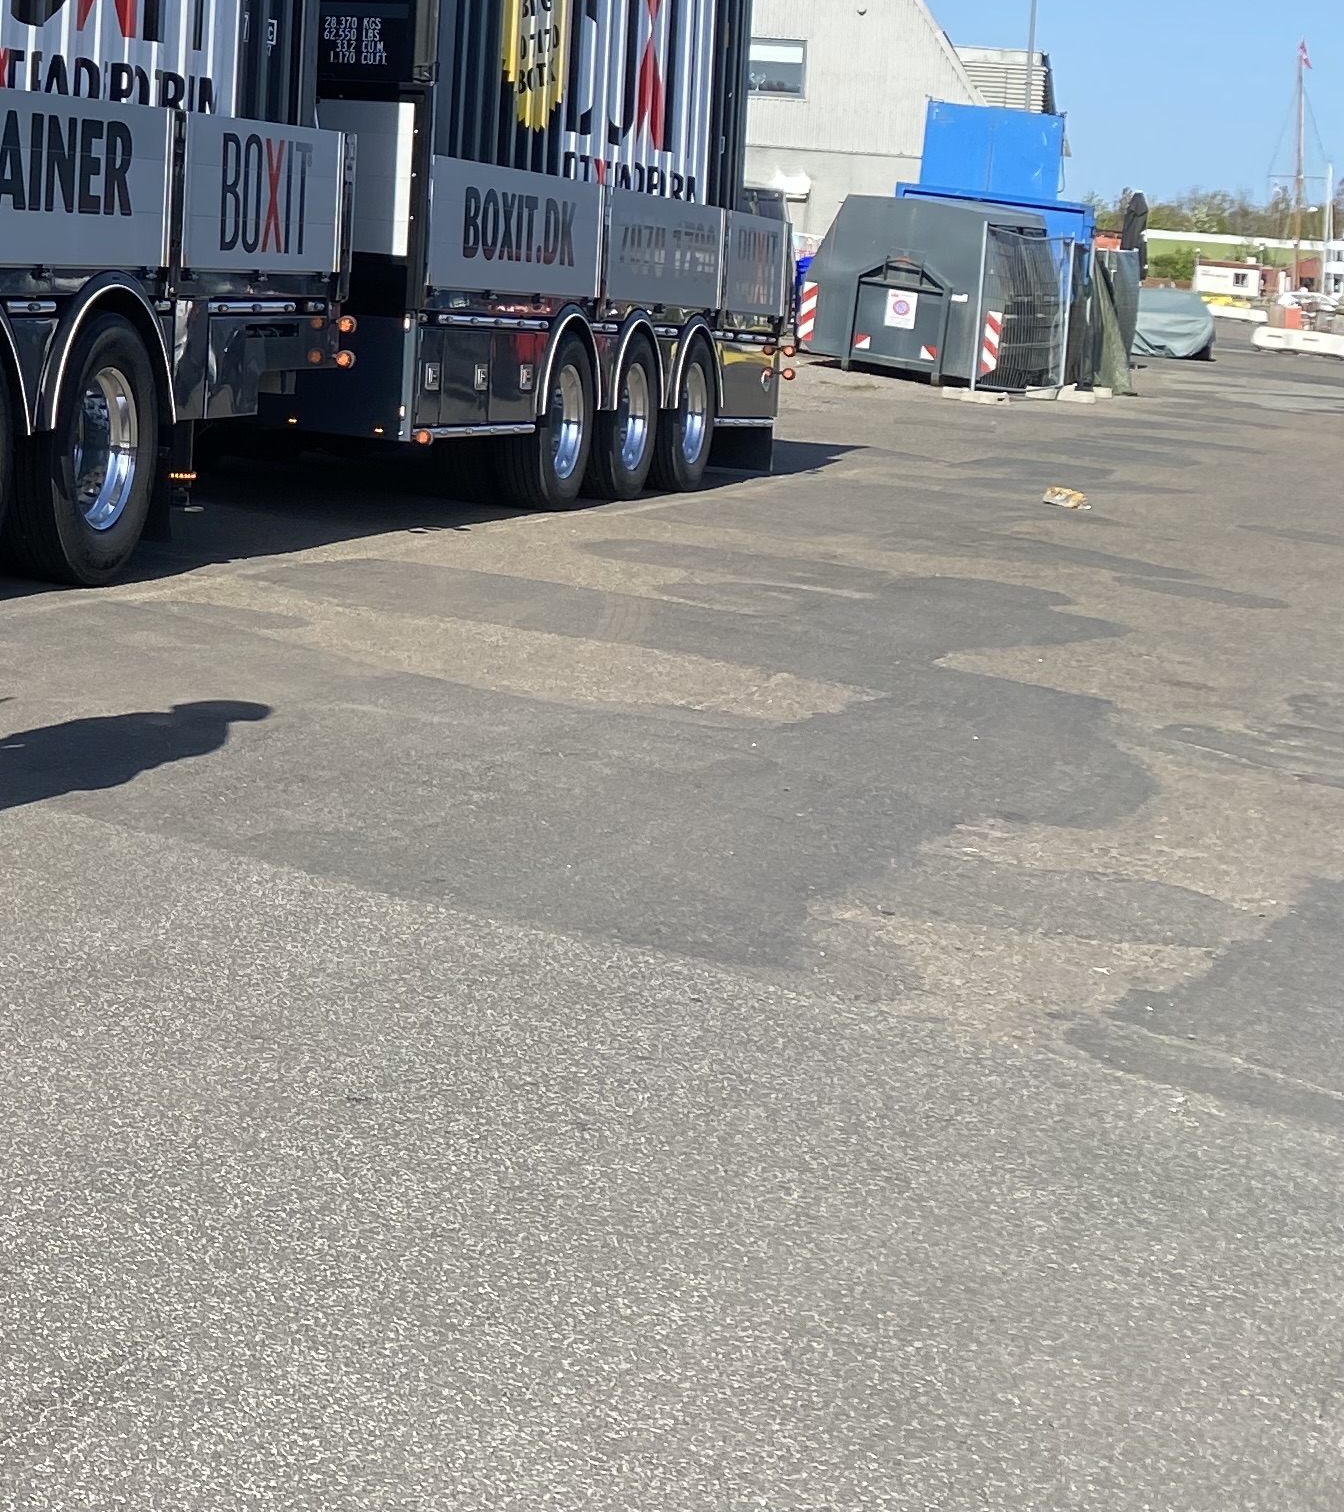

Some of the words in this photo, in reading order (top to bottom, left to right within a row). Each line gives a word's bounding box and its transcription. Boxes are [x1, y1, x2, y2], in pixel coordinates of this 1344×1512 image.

[363, 17, 382, 29] KGS
[362, 28, 380, 41] LBS
[462, 185, 577, 268] BOXIT.DK
